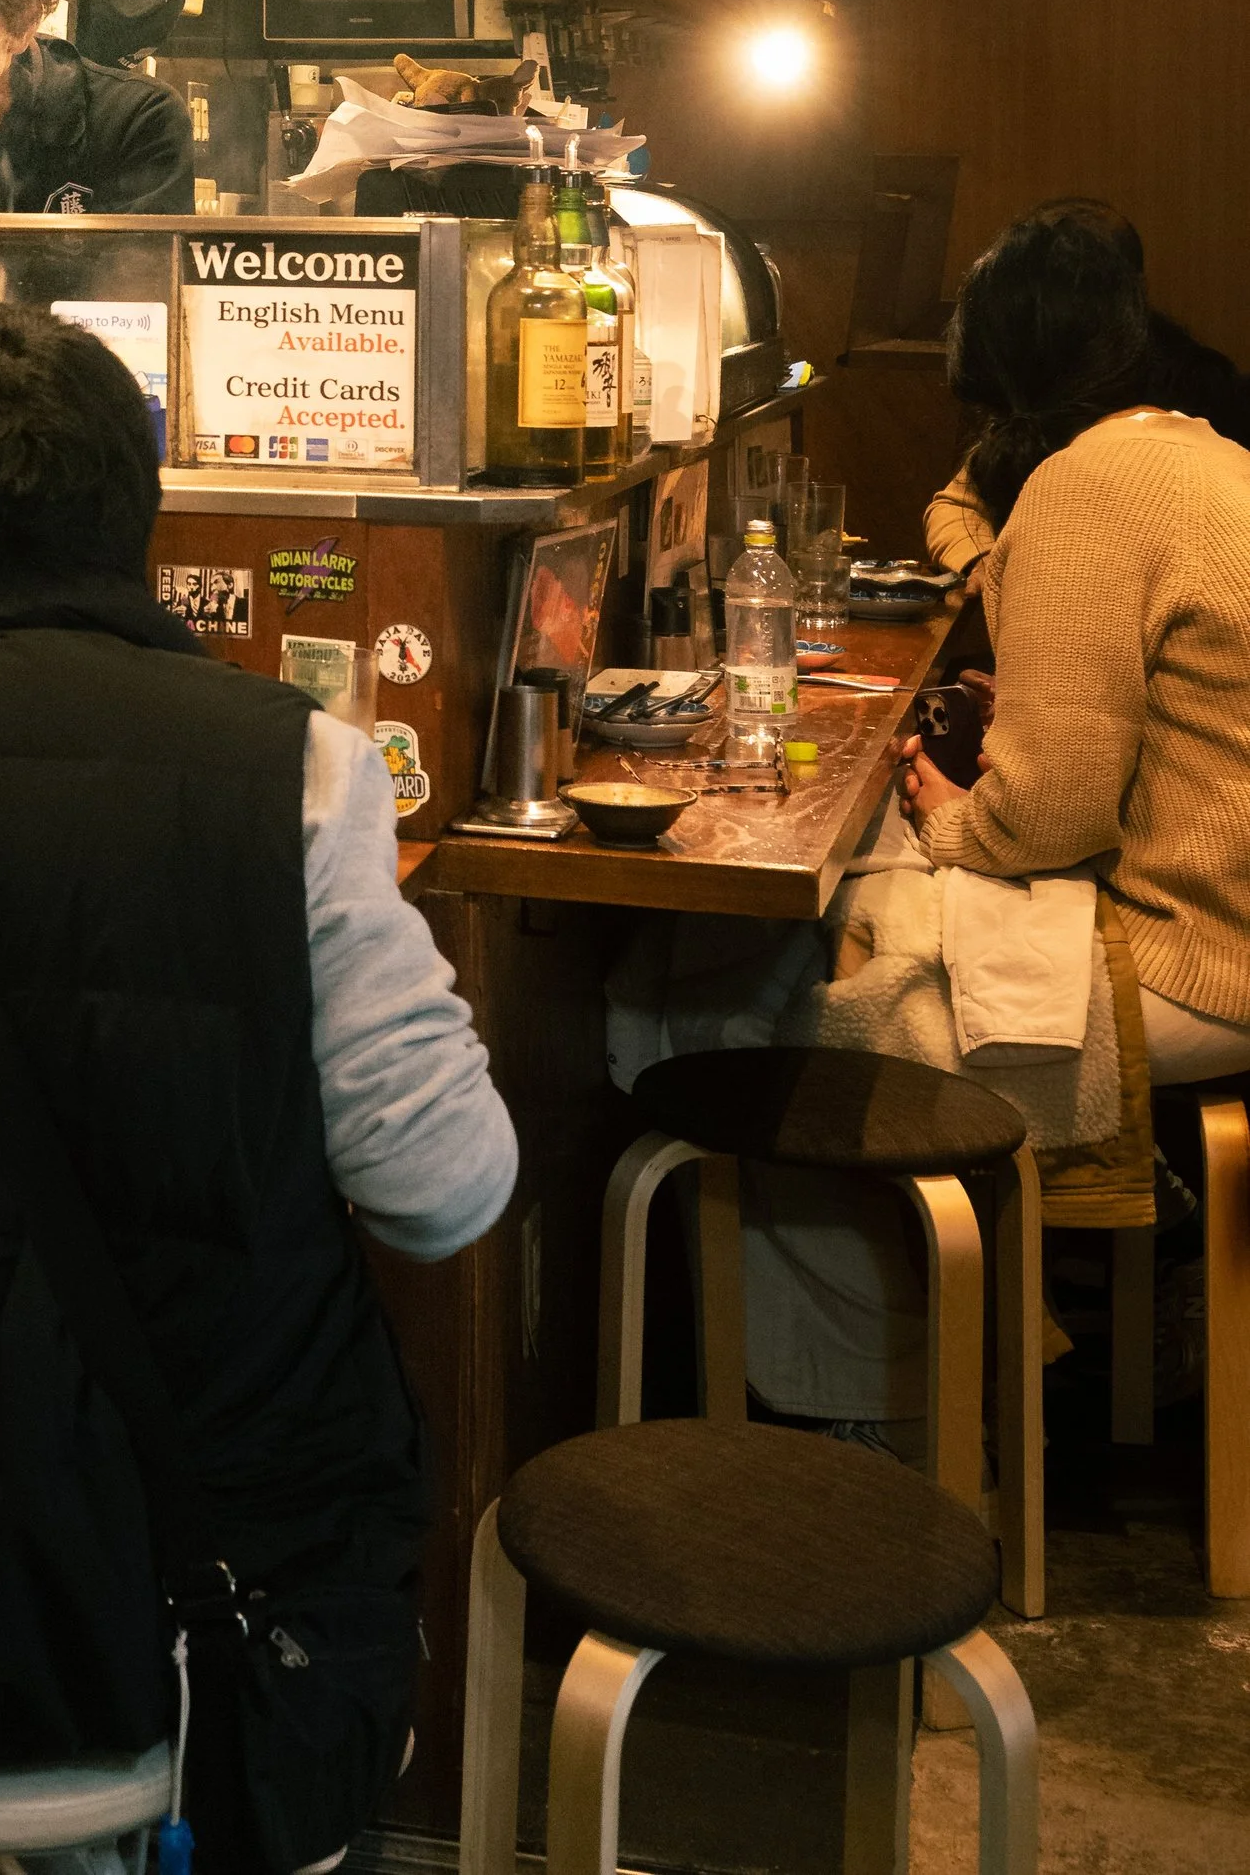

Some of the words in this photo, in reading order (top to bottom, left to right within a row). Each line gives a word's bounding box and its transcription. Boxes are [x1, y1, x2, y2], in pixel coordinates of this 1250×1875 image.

[188, 241, 405, 284] Welcome
[96, 317, 109, 327] to
[111, 316, 133, 330] Pay
[218, 300, 320, 329] English
[328, 303, 405, 327] Menu
[277, 330, 405, 355] Available.
[543, 344, 561, 353] THE
[226, 374, 310, 400] Credit
[319, 378, 400, 403] Cards
[554, 378, 566, 391] 12
[276, 405, 406, 432] Accepted.
[269, 441, 298, 453] JCB
[270, 551, 311, 568] INDIAN
[312, 551, 357, 574] LARRY
[161, 568, 172, 601] FEED
[269, 571, 355, 592] MOTORCYCLES
[376, 626, 401, 656] BAJA
[406, 626, 431, 657] DAVE
[389, 671, 418, 683] 2023
